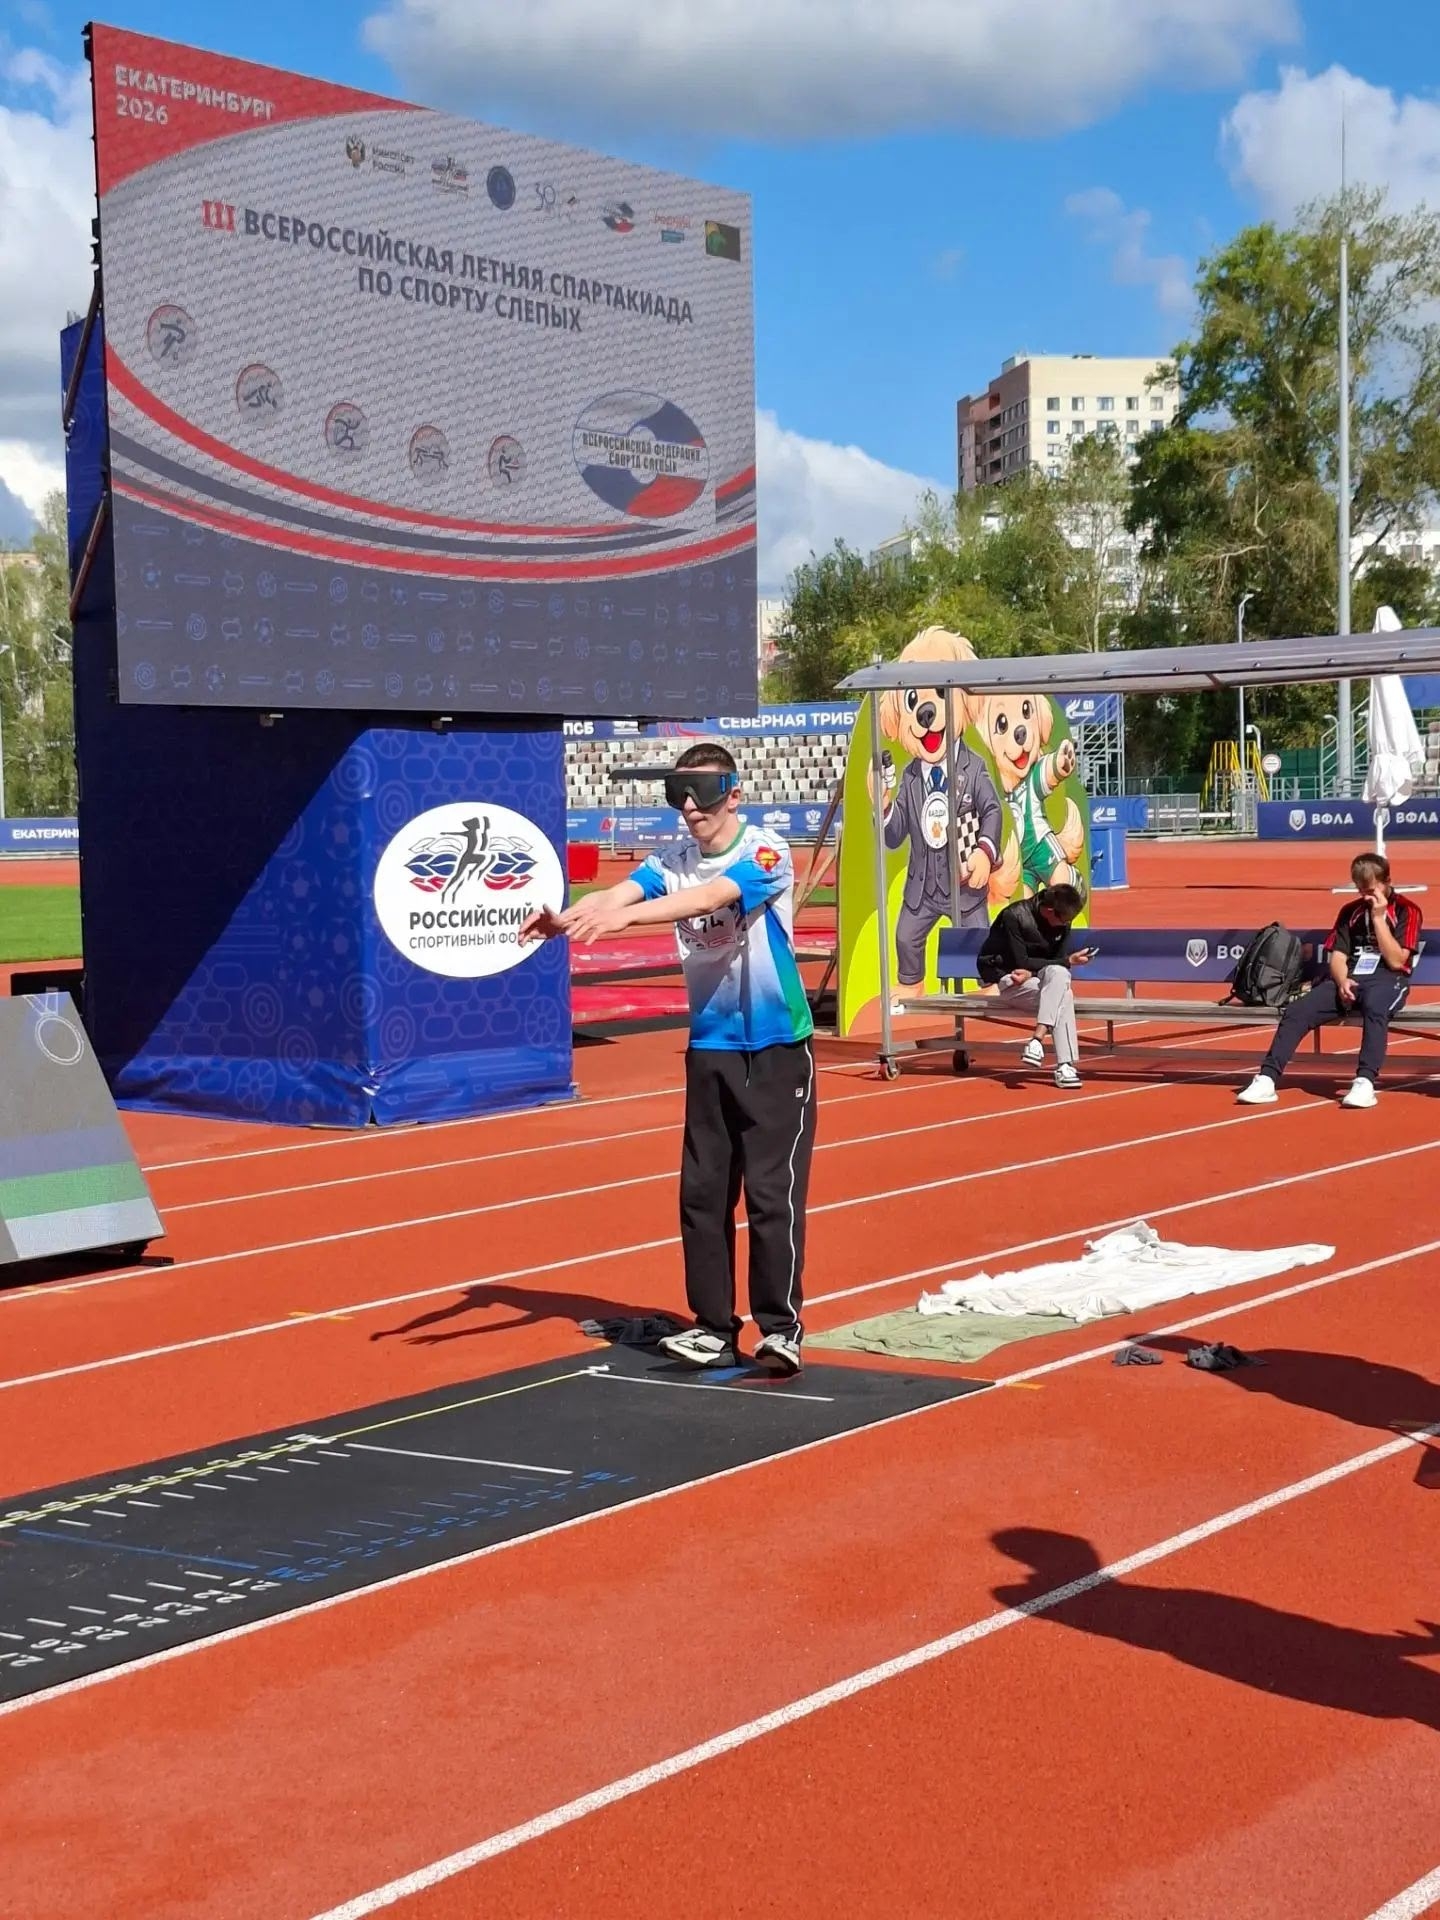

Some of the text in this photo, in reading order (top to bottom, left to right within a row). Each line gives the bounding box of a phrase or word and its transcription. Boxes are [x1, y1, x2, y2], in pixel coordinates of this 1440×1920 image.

[115, 64, 275, 120] ЕКАТЕРИНБУРГ
[116, 94, 169, 125] 2026
[202, 200, 693, 325] III ВСЕРОССИЙСКАЯ ЛЕТНЯЯ СПАРТАКИАДА
[358, 267, 582, 333] ПО СПОРТУ СЛЕПЫХ
[563, 721, 594, 735] ПСБ
[719, 711, 858, 729] СЕВЕРНАЯ ТРИБ
[1311, 813, 1354, 825] ВФЛА
[1396, 812, 1439, 823] ВФЛА
[12, 828, 79, 839] ЕКАТЕРИН
[409, 902, 534, 930] РОССИЙСКИЙ
[409, 930, 535, 949] СПОРТИВНЫЙ ФО
